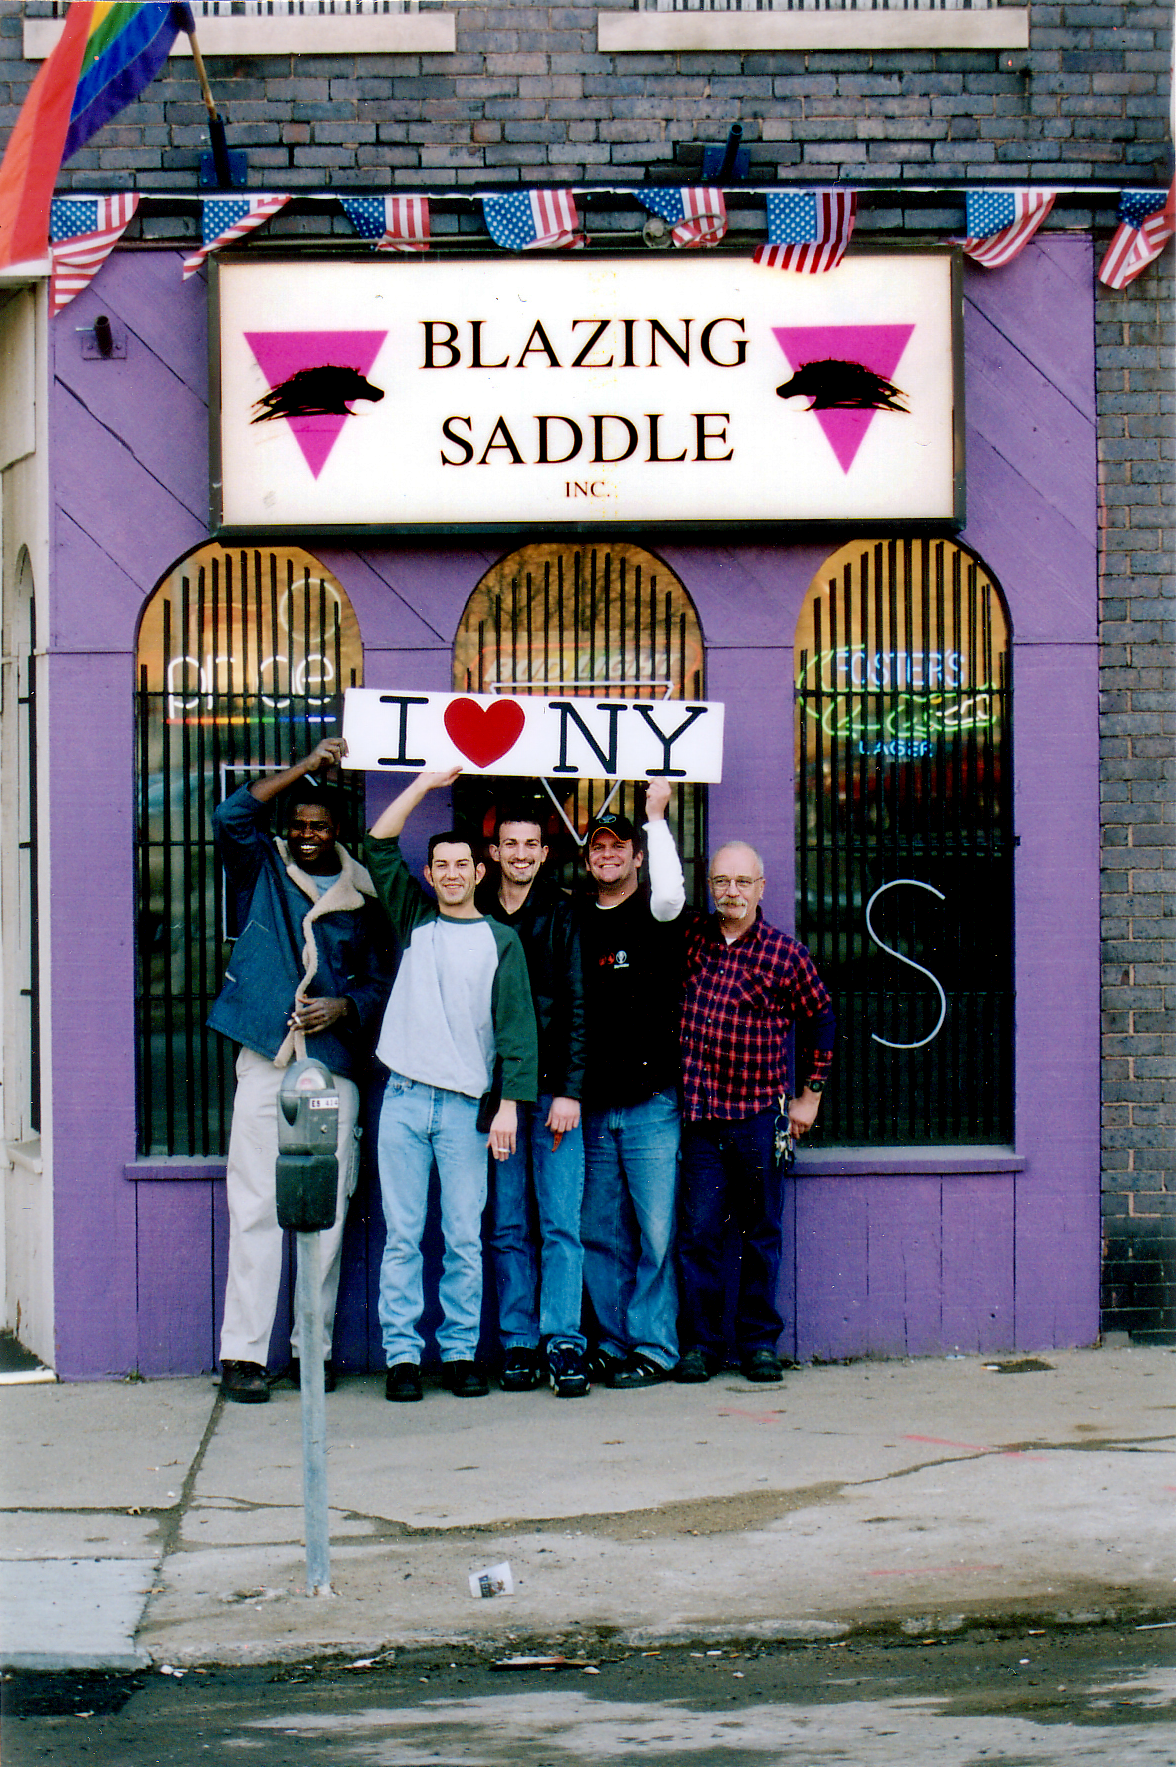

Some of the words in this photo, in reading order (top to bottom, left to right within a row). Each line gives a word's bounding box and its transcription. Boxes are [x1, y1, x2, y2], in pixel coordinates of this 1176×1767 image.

[419, 317, 750, 369] BLAZING
[440, 412, 734, 466] SADDLE
[565, 481, 610, 498] INC.
[168, 655, 334, 719] prde
[484, 656, 569, 682] BUD
[571, 653, 680, 680] LIGHT
[378, 695, 429, 767] I
[548, 701, 708, 777] NY
